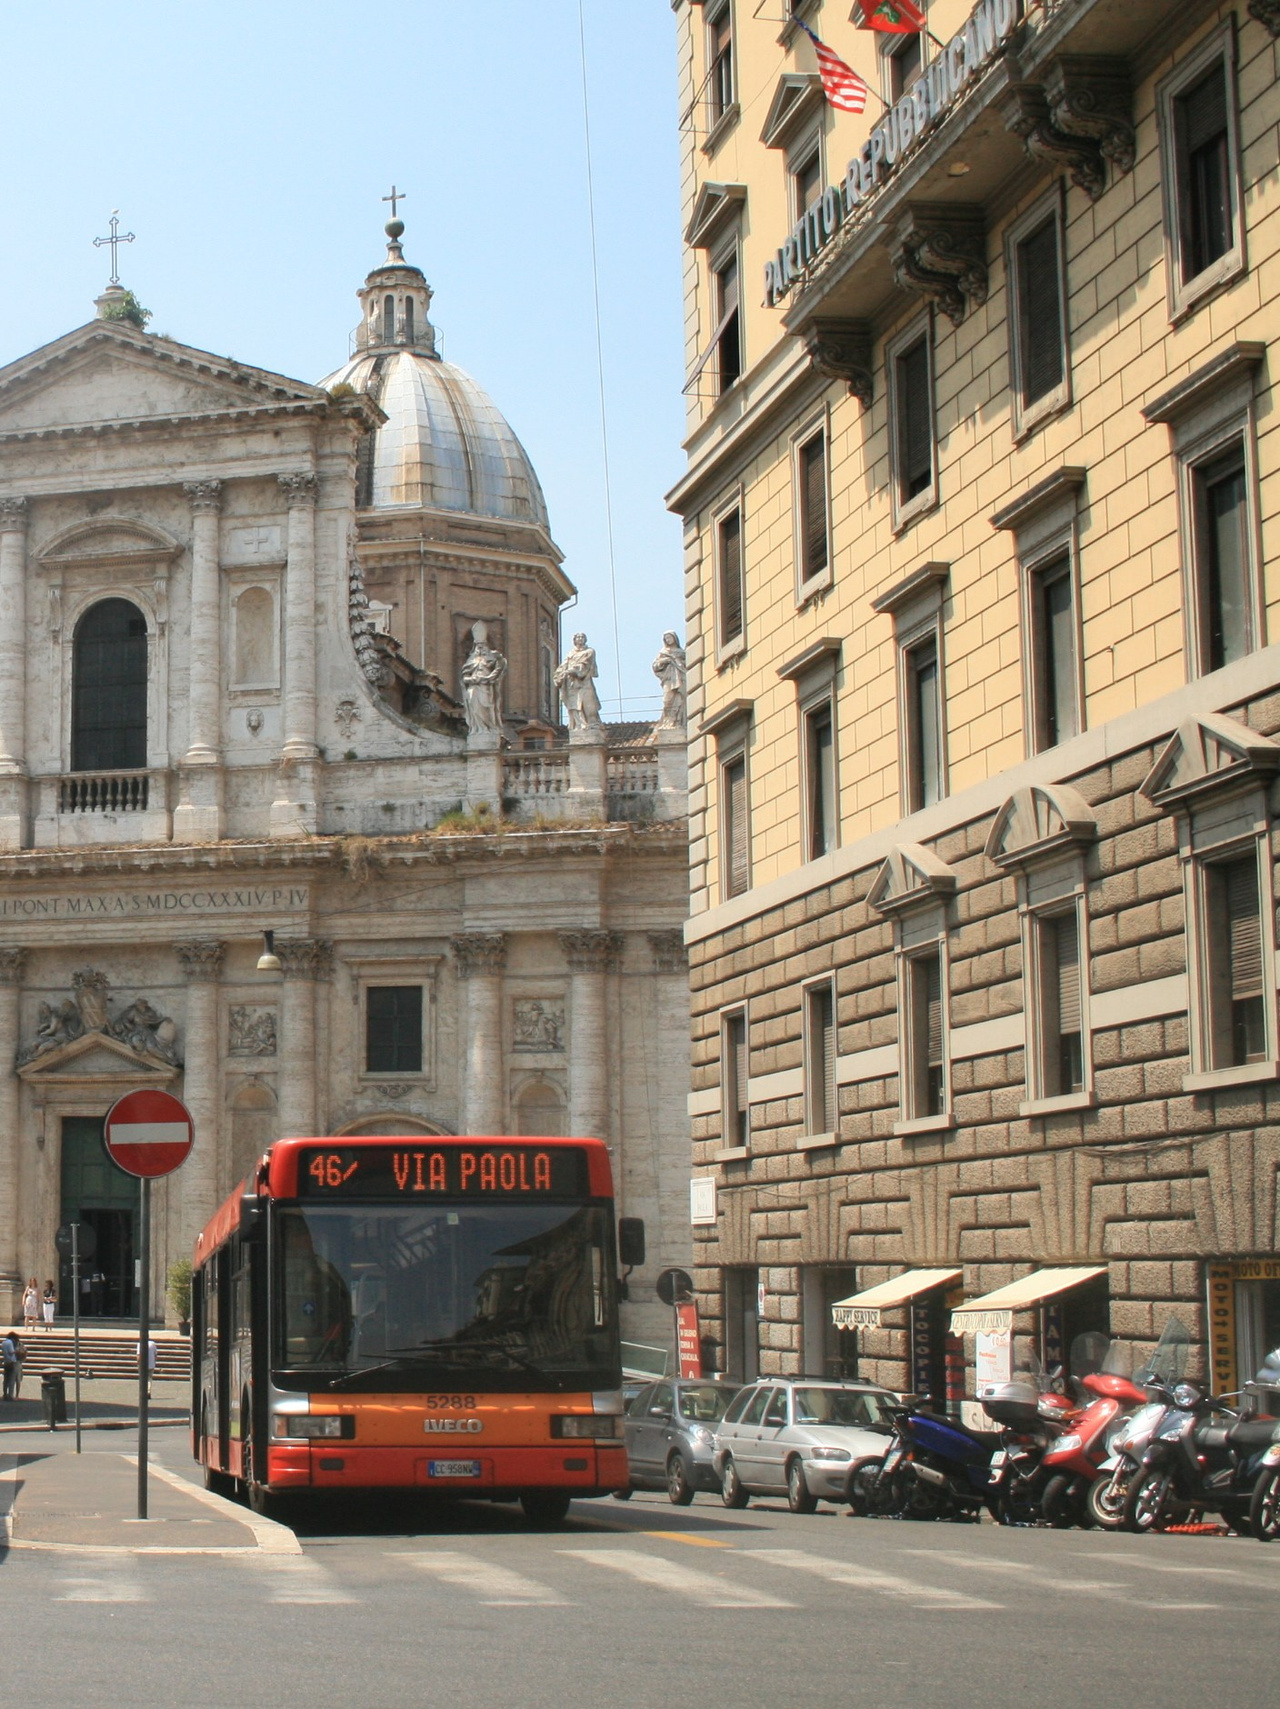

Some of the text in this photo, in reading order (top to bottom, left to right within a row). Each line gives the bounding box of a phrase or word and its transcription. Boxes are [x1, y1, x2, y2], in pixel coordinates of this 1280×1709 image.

[764, 0, 1021, 306] PARTITO REPUBBLICANO
[13, 898, 60, 916] PONT
[68, 896, 108, 913] MAX
[113, 896, 124, 911] A
[146, 890, 267, 911] MDCCXXXIV
[393, 1153, 446, 1190] VIA
[460, 1153, 550, 1190] PAOLA
[1264, 1262, 1280, 1277] OF
[834, 1309, 878, 1325] HAPPY SERVICE
[426, 1395, 476, 1410] 5288
[424, 1418, 483, 1433] IVECO
